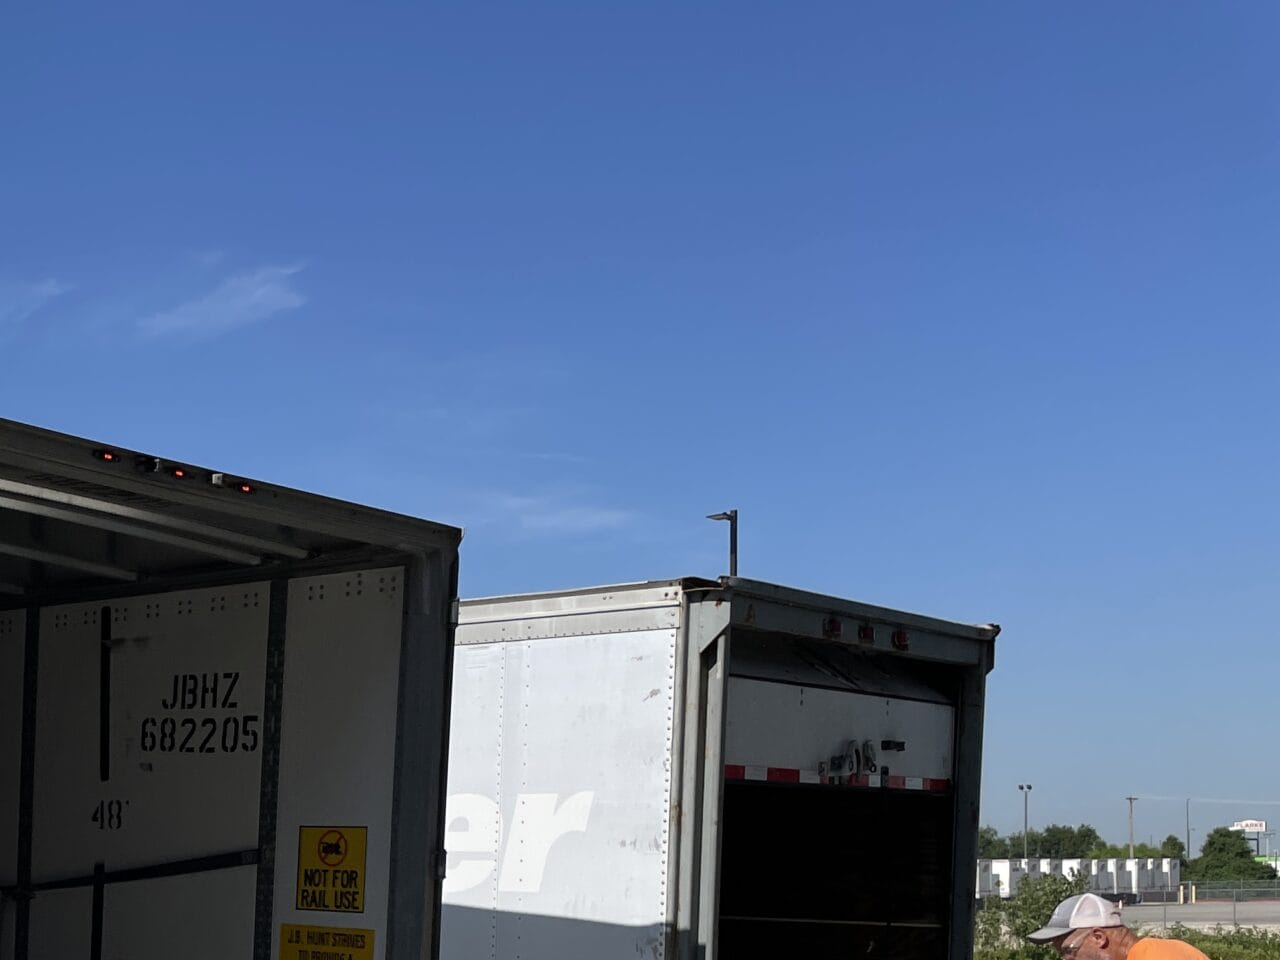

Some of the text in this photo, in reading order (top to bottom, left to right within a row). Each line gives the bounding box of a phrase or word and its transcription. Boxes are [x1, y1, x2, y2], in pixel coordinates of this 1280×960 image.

[161, 672, 240, 710] JBHZ
[140, 715, 259, 753] 682205
[443, 790, 595, 893] er
[303, 868, 359, 889] NOT FOR
[301, 889, 360, 910] RAIL USE
